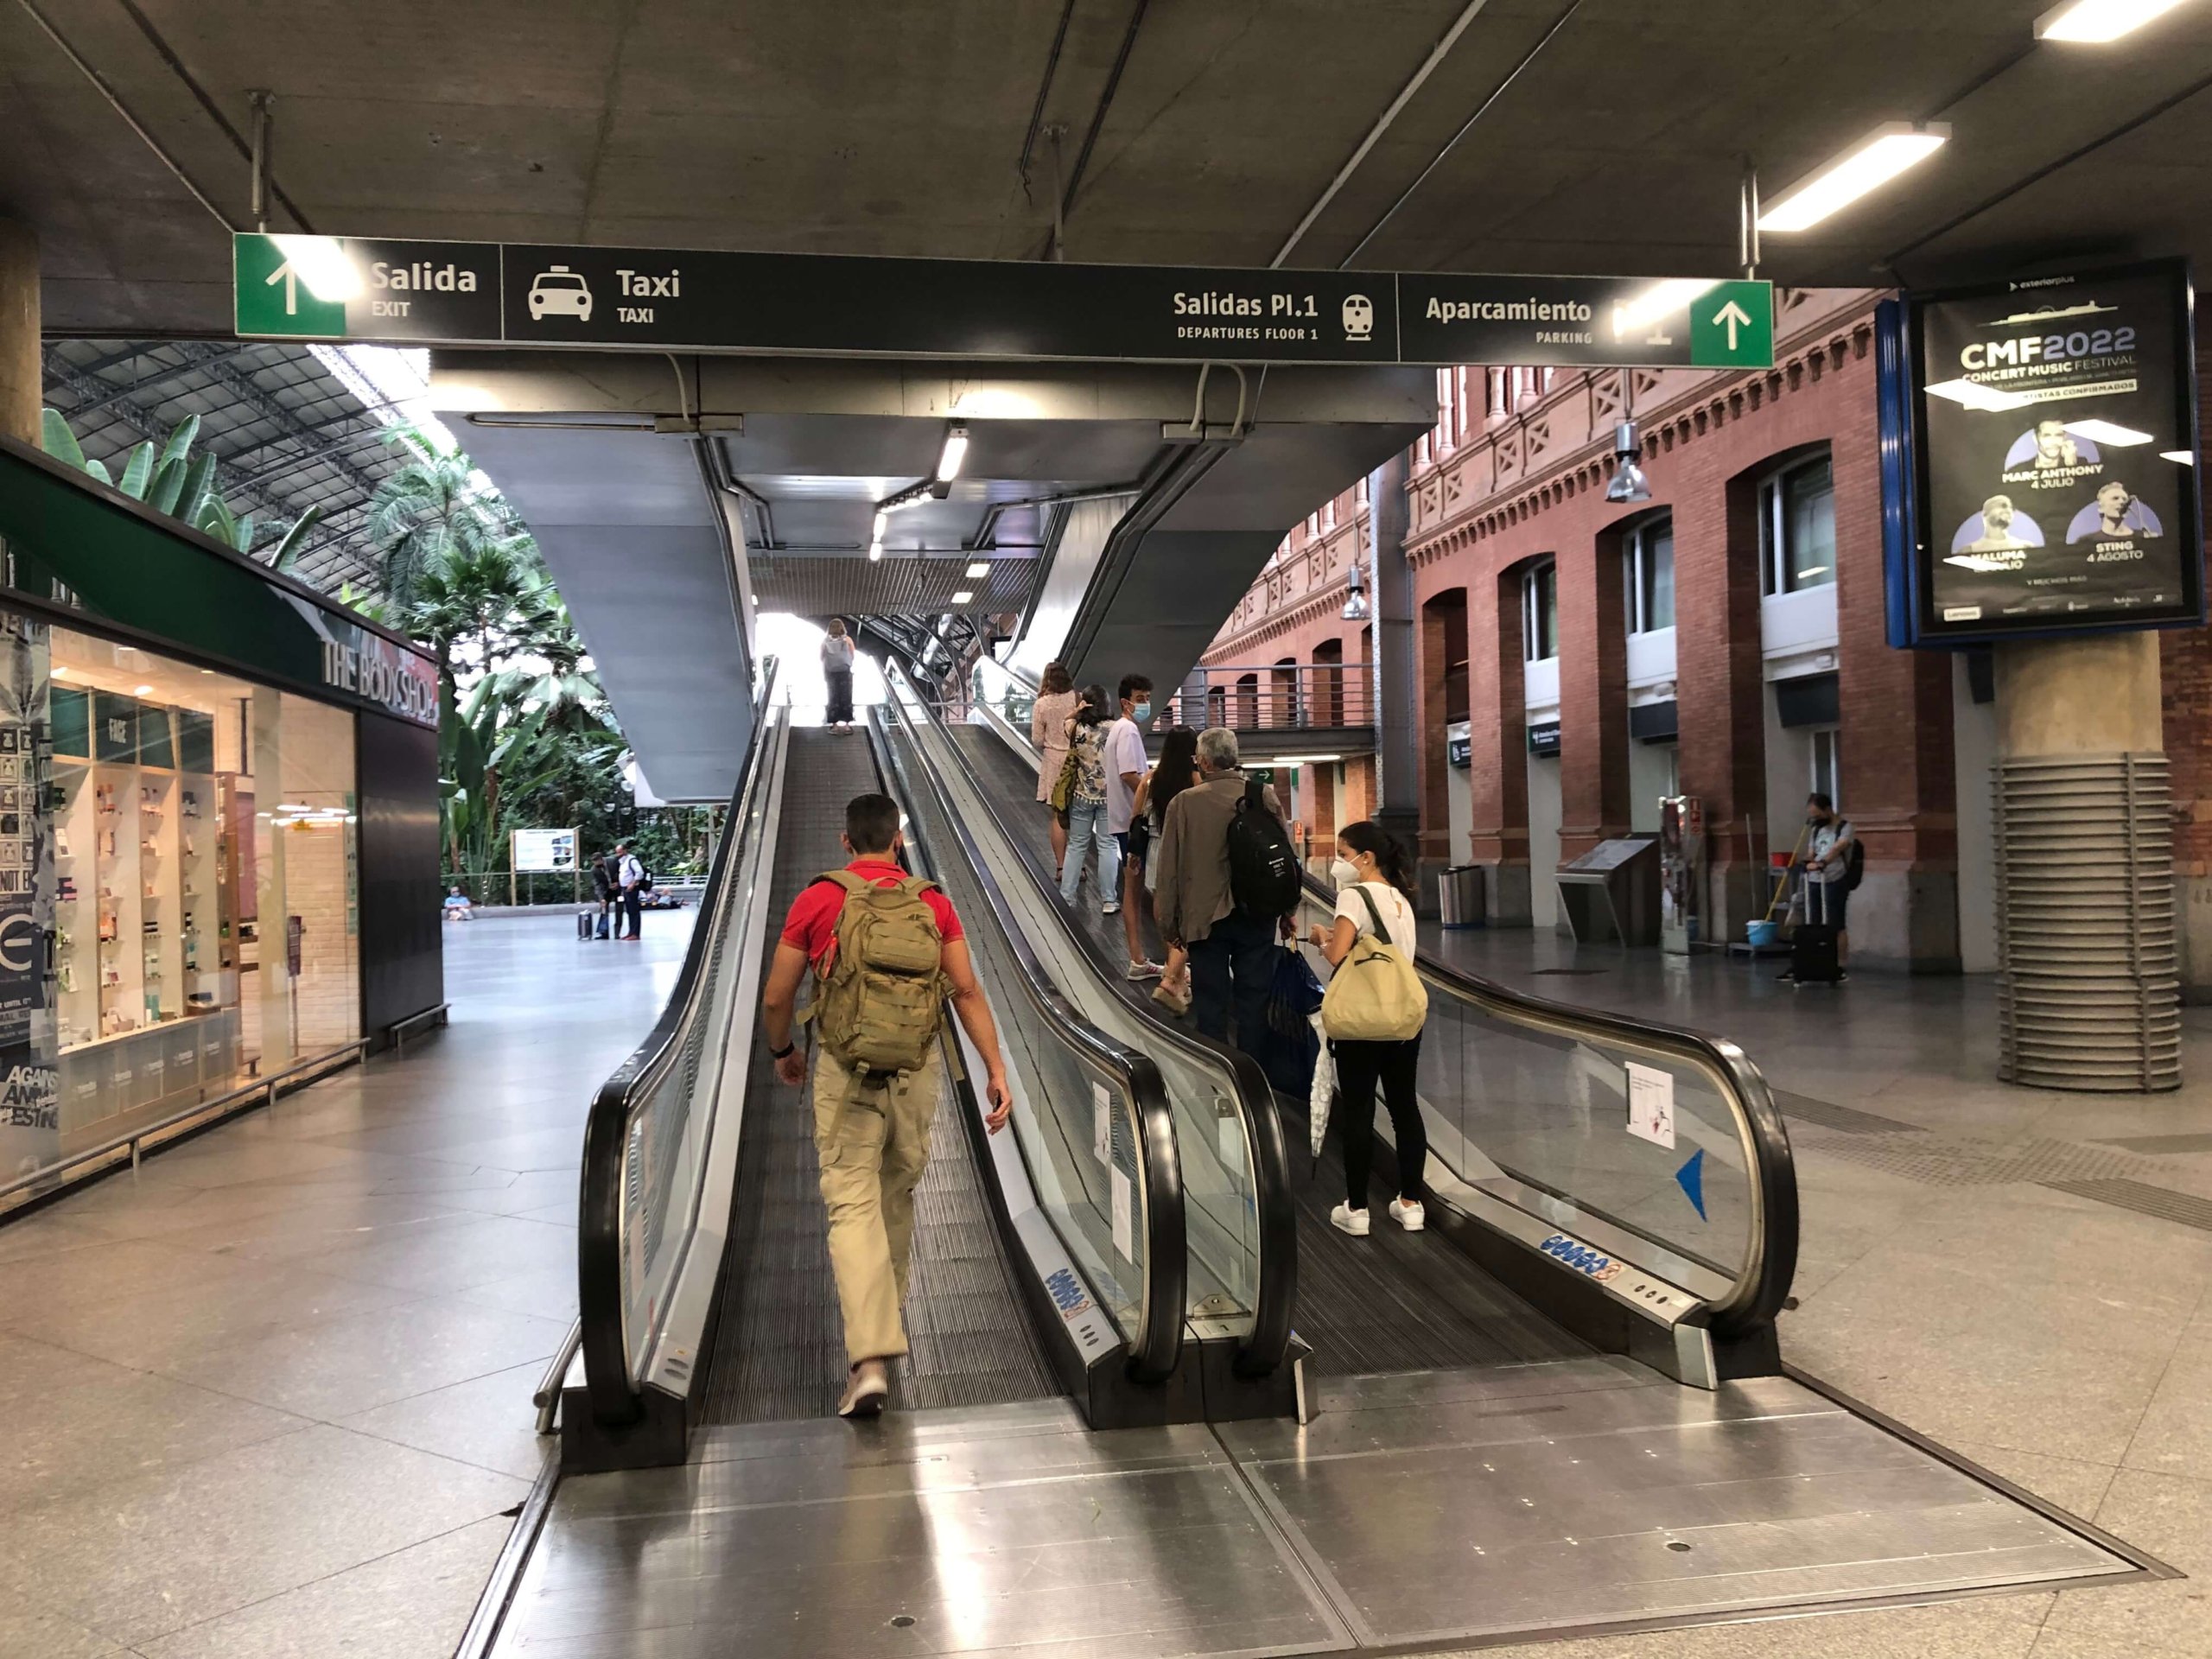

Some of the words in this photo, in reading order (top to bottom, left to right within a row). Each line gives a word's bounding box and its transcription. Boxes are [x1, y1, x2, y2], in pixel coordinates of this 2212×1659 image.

[371, 262, 476, 292] Salida
[616, 269, 680, 297] Taxi
[372, 302, 410, 317] EXIT
[1173, 291, 1262, 316] Salidas
[1271, 294, 1319, 317] Pl.1
[1426, 297, 1592, 324] Aparcamiento
[617, 308, 654, 323] TAXI
[1178, 327, 1260, 340] DEPARTURES
[1265, 327, 1305, 340] FLOOR
[1311, 328, 1319, 340] 1
[1536, 332, 1592, 344] PARKING
[1961, 327, 2136, 371] CMF2022
[1962, 366, 2026, 384] CONCERT
[2028, 360, 2073, 376] MUSIC
[2075, 355, 2136, 370] FESTIVAL
[2063, 381, 2135, 397] CONFIRMADOS
[2001, 470, 2040, 483] MARC
[2040, 464, 2104, 480] ANTHONY
[2031, 480, 2039, 489] 4
[2040, 477, 2075, 489] JULIO
[2095, 541, 2134, 553] STING
[1970, 550, 2027, 562] MALUMA
[2086, 553, 2094, 563] 4
[2096, 550, 2144, 562] AGOSTO
[321, 637, 357, 691] THE
[359, 653, 403, 707] BODY
[400, 669, 436, 725] SHOP
